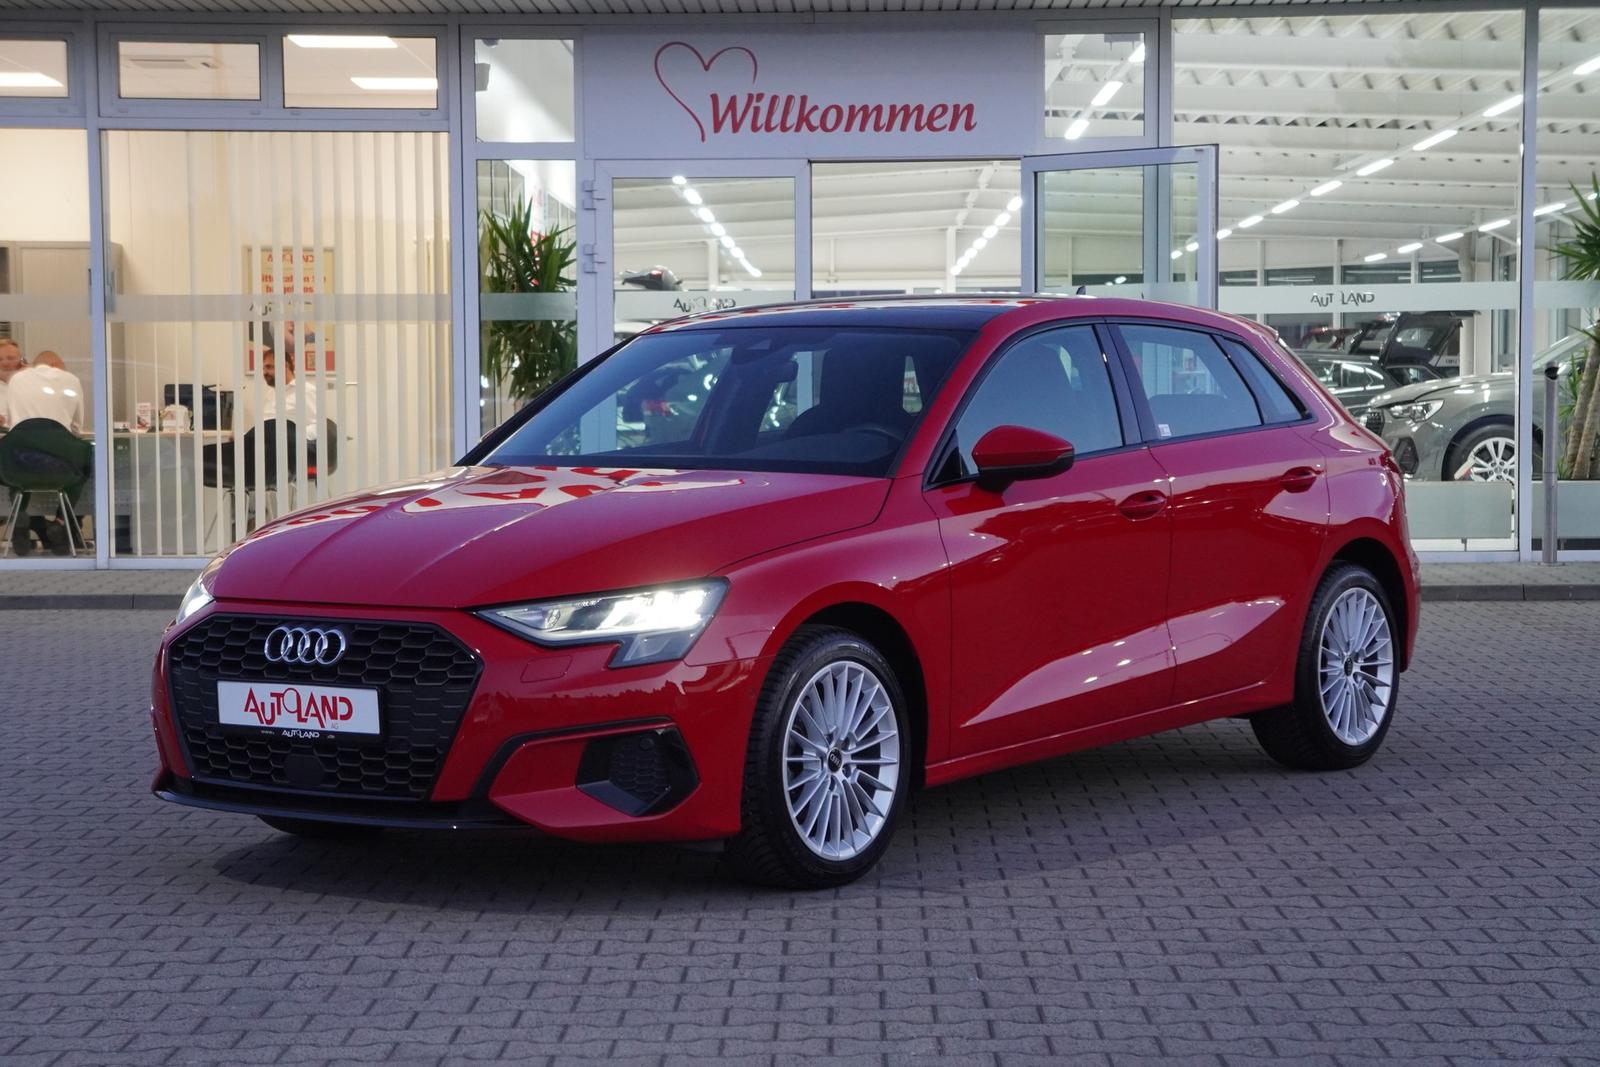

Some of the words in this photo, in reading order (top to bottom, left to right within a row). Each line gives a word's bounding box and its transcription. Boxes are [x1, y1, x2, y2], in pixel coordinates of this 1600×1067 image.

[709, 92, 978, 134] Willkommen
[1310, 291, 1376, 308] AUTLAND
[244, 687, 353, 729] AUTOLAND
